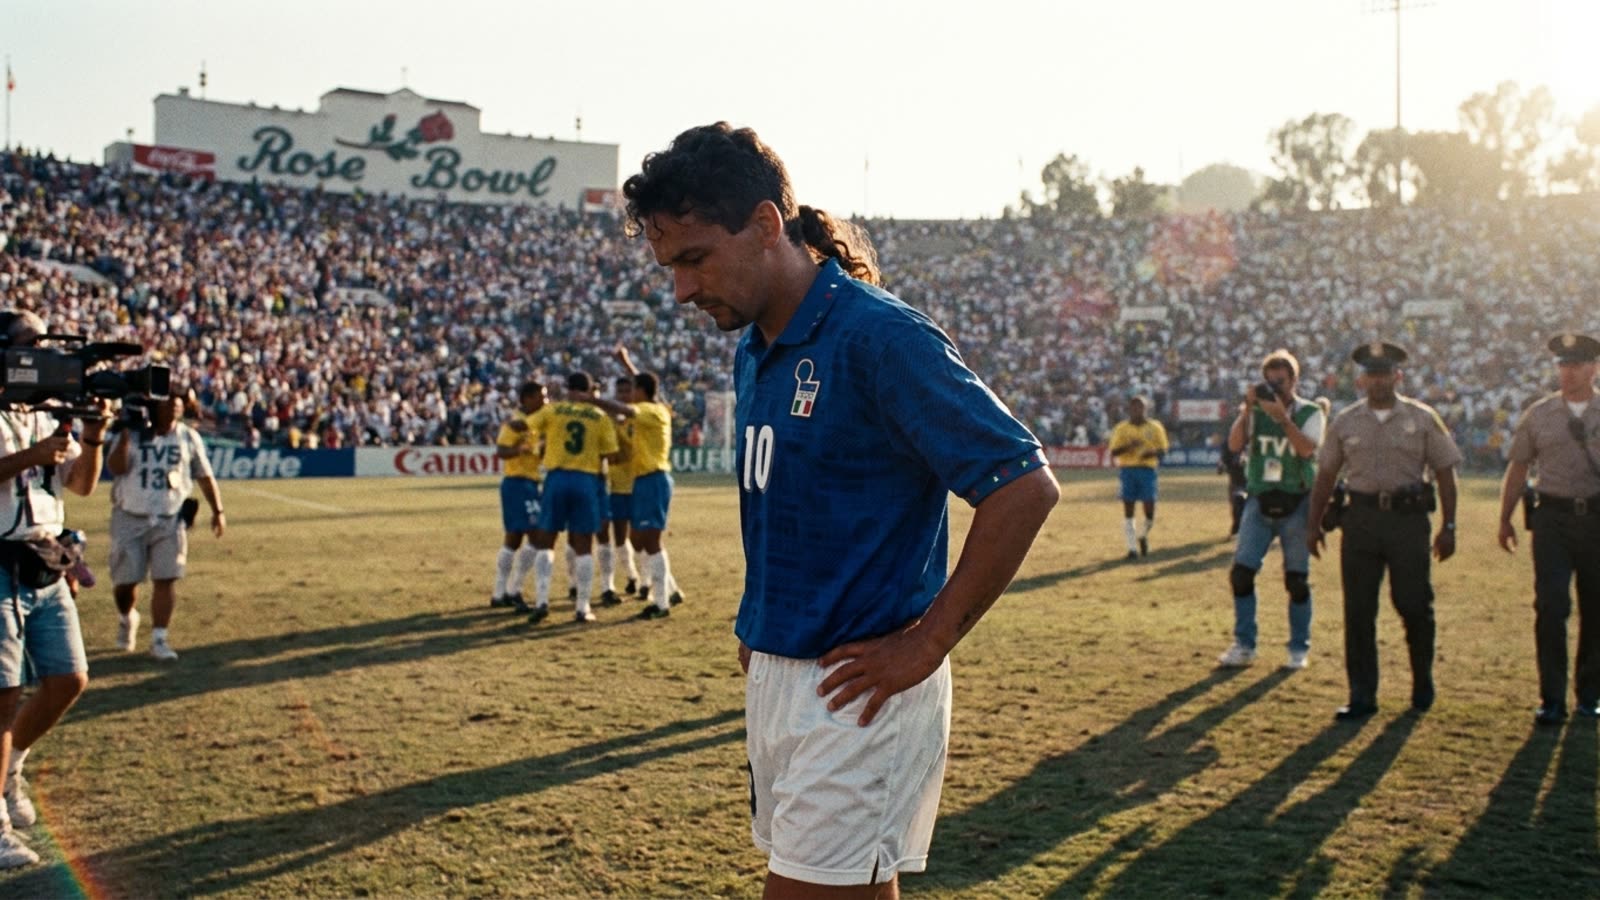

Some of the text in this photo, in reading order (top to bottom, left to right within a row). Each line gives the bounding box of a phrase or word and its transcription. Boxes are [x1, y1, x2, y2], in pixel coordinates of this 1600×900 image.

[237, 126, 556, 197] Rose Bowl
[564, 420, 586, 456] 3
[743, 424, 774, 494] 10
